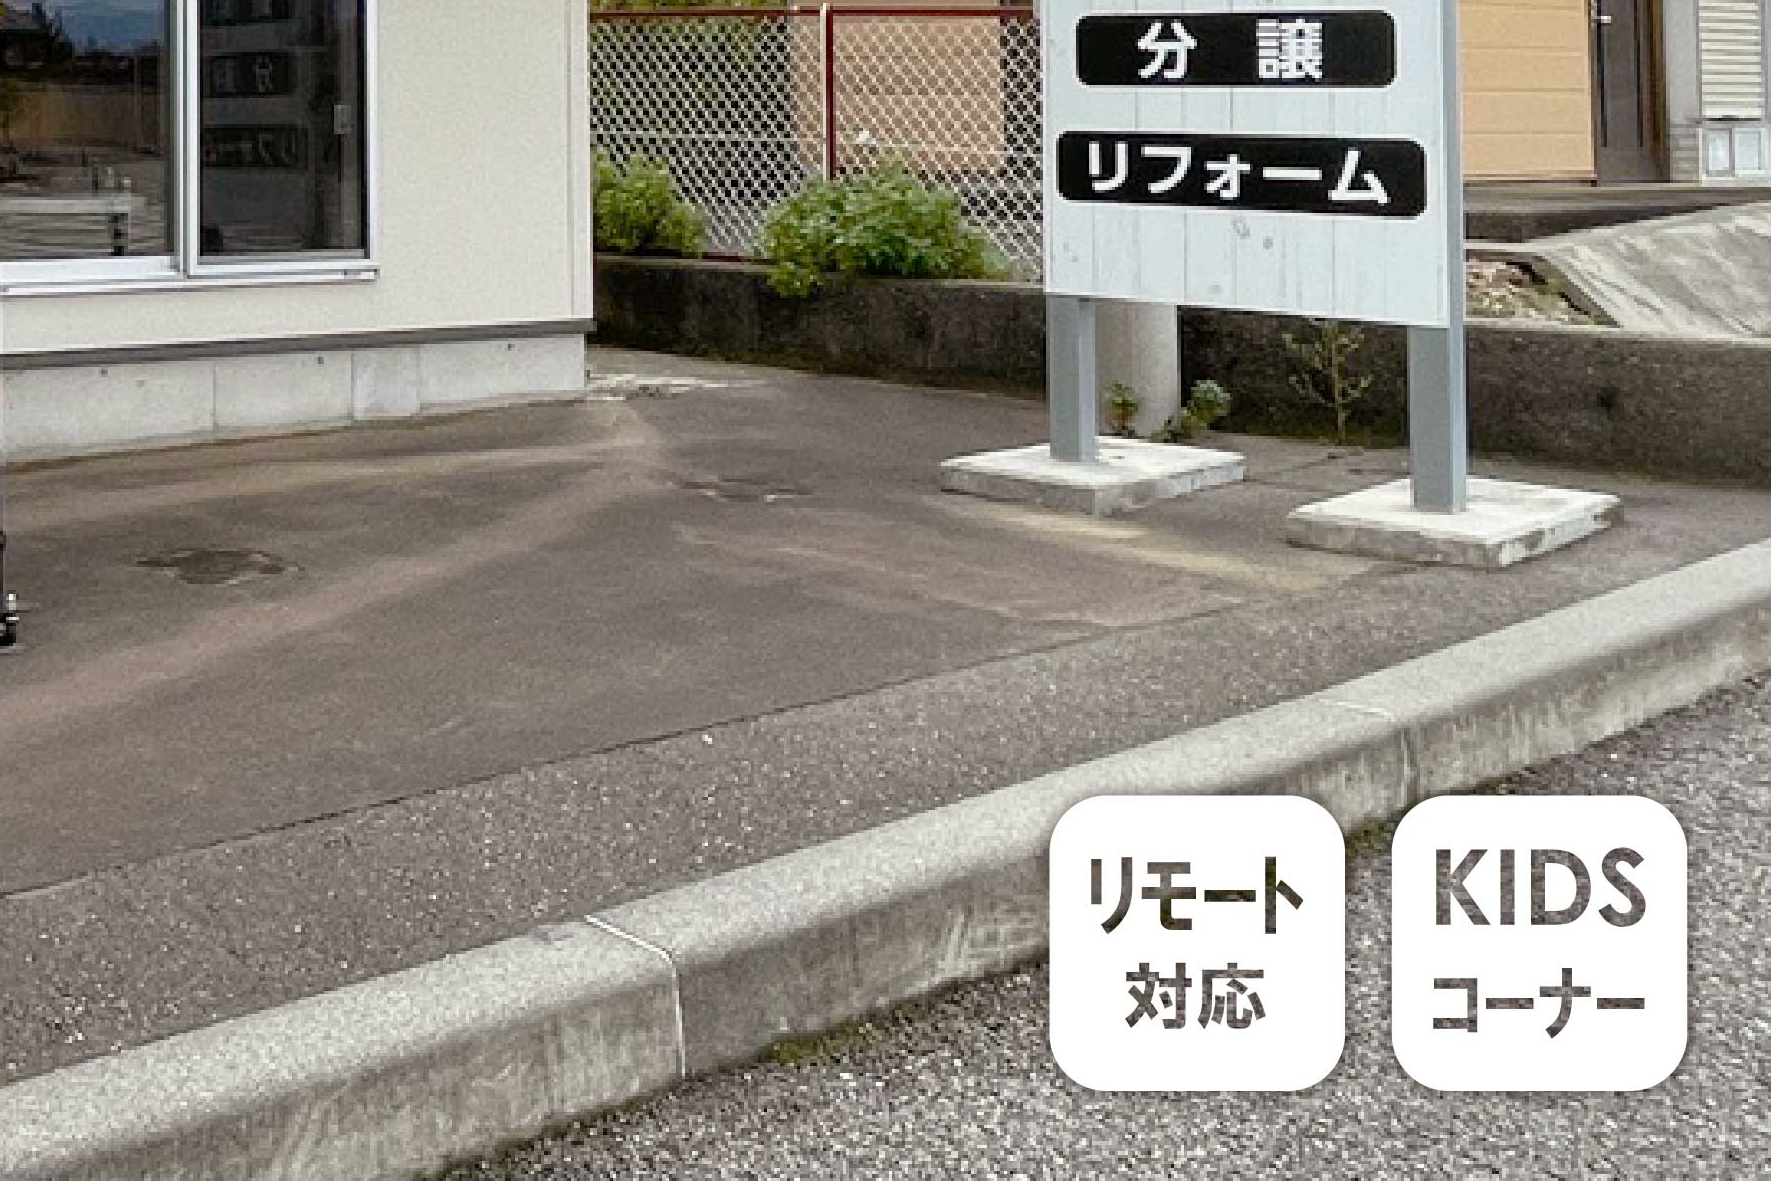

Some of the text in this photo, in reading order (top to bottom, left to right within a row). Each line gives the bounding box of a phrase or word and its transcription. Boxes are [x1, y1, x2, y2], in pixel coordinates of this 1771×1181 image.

[1136, 19, 1323, 83] 分譲
[1088, 143, 1389, 206] リフォーム
